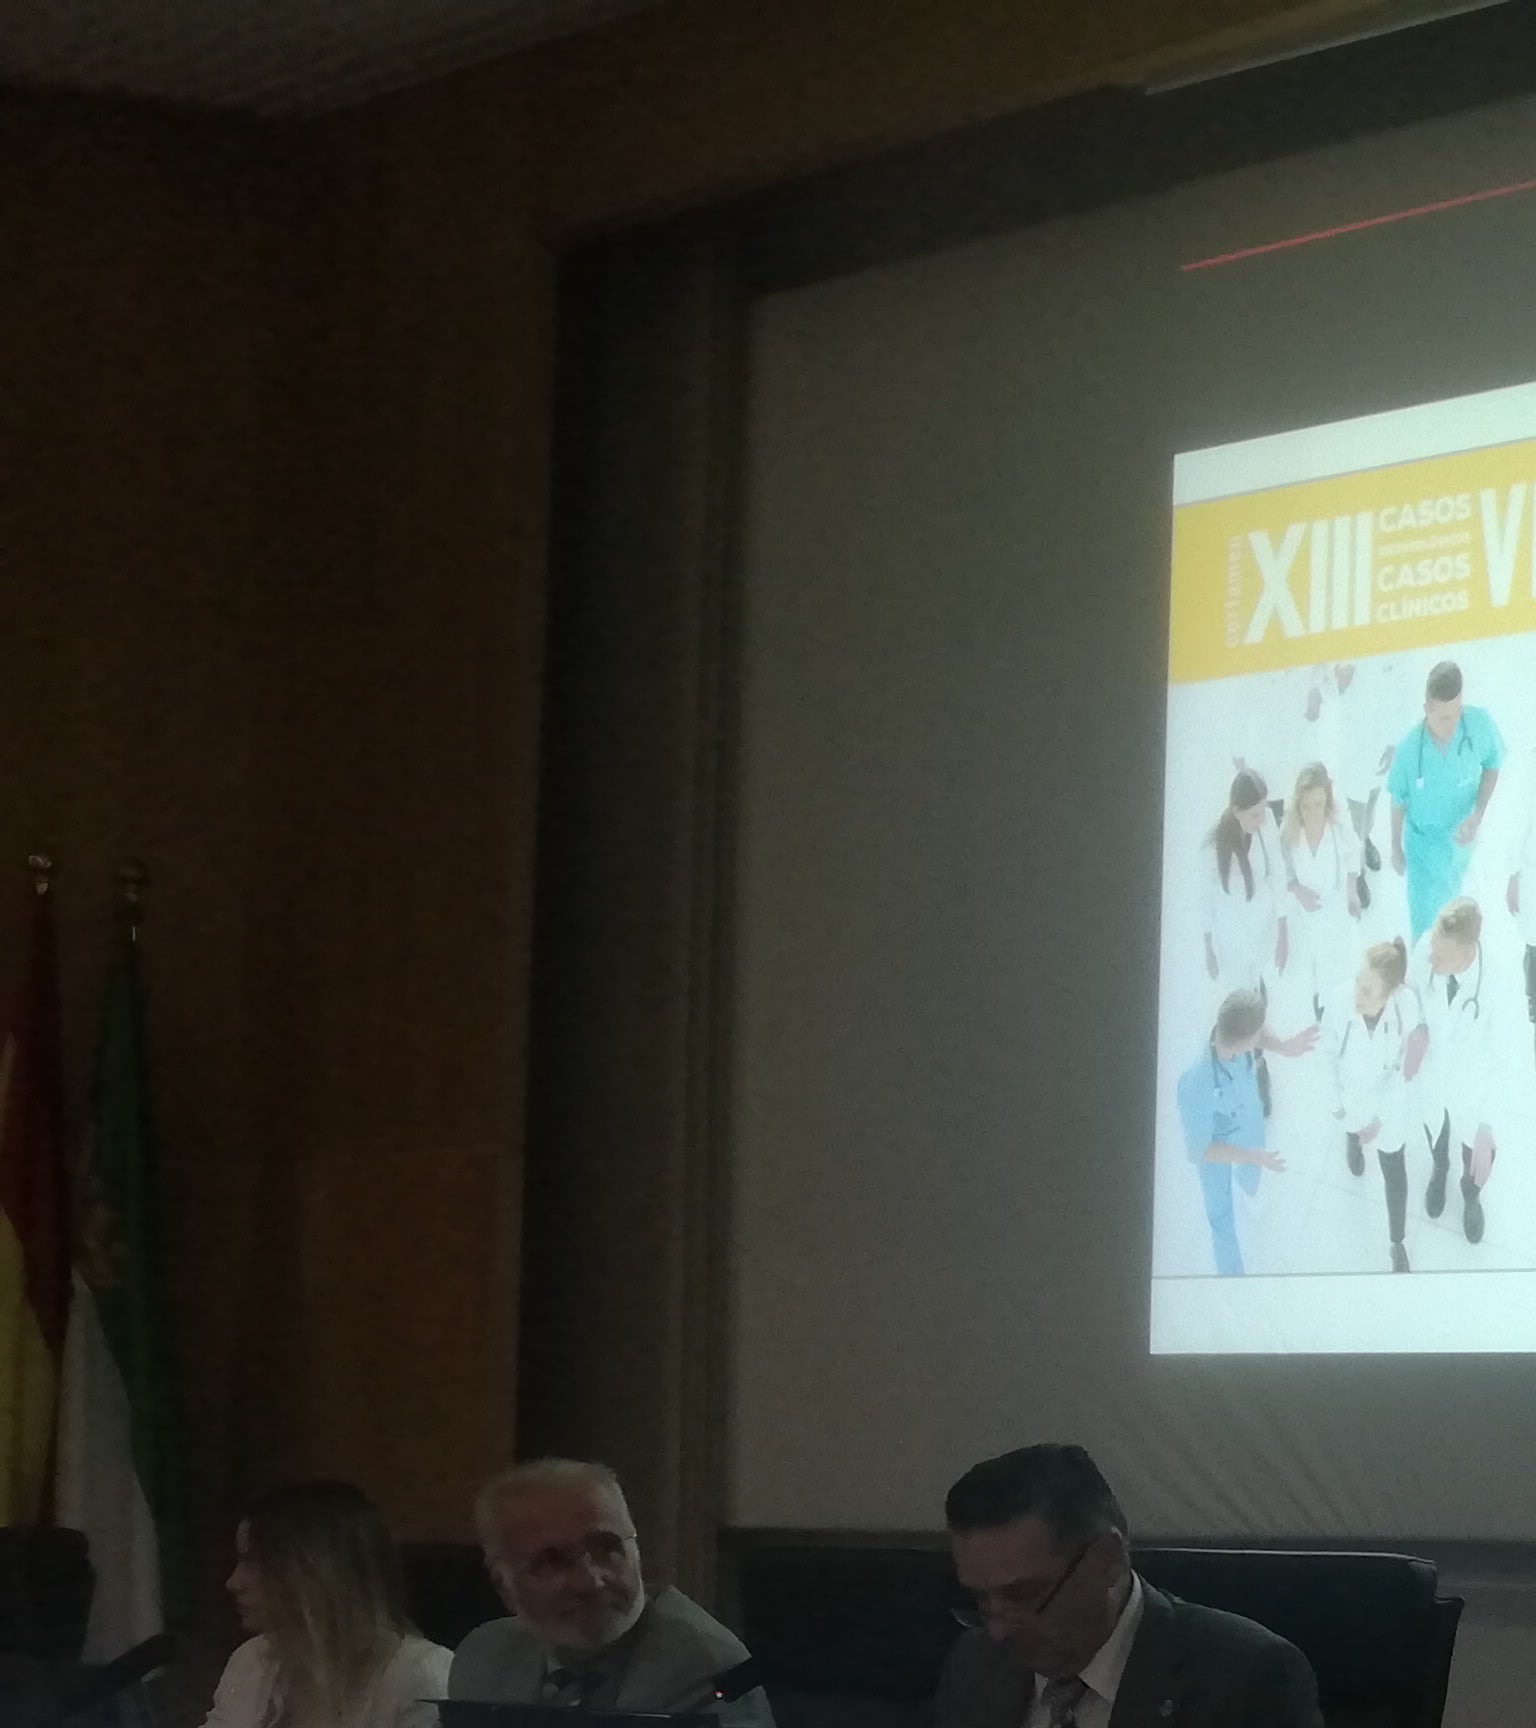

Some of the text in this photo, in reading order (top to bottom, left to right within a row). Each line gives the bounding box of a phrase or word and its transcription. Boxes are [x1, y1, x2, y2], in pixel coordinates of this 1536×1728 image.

[1377, 492, 1473, 535] CASOS
[1243, 511, 1374, 645] XIII
[1375, 552, 1471, 594] CASOS
[1375, 589, 1470, 624] CLÍNICOS
